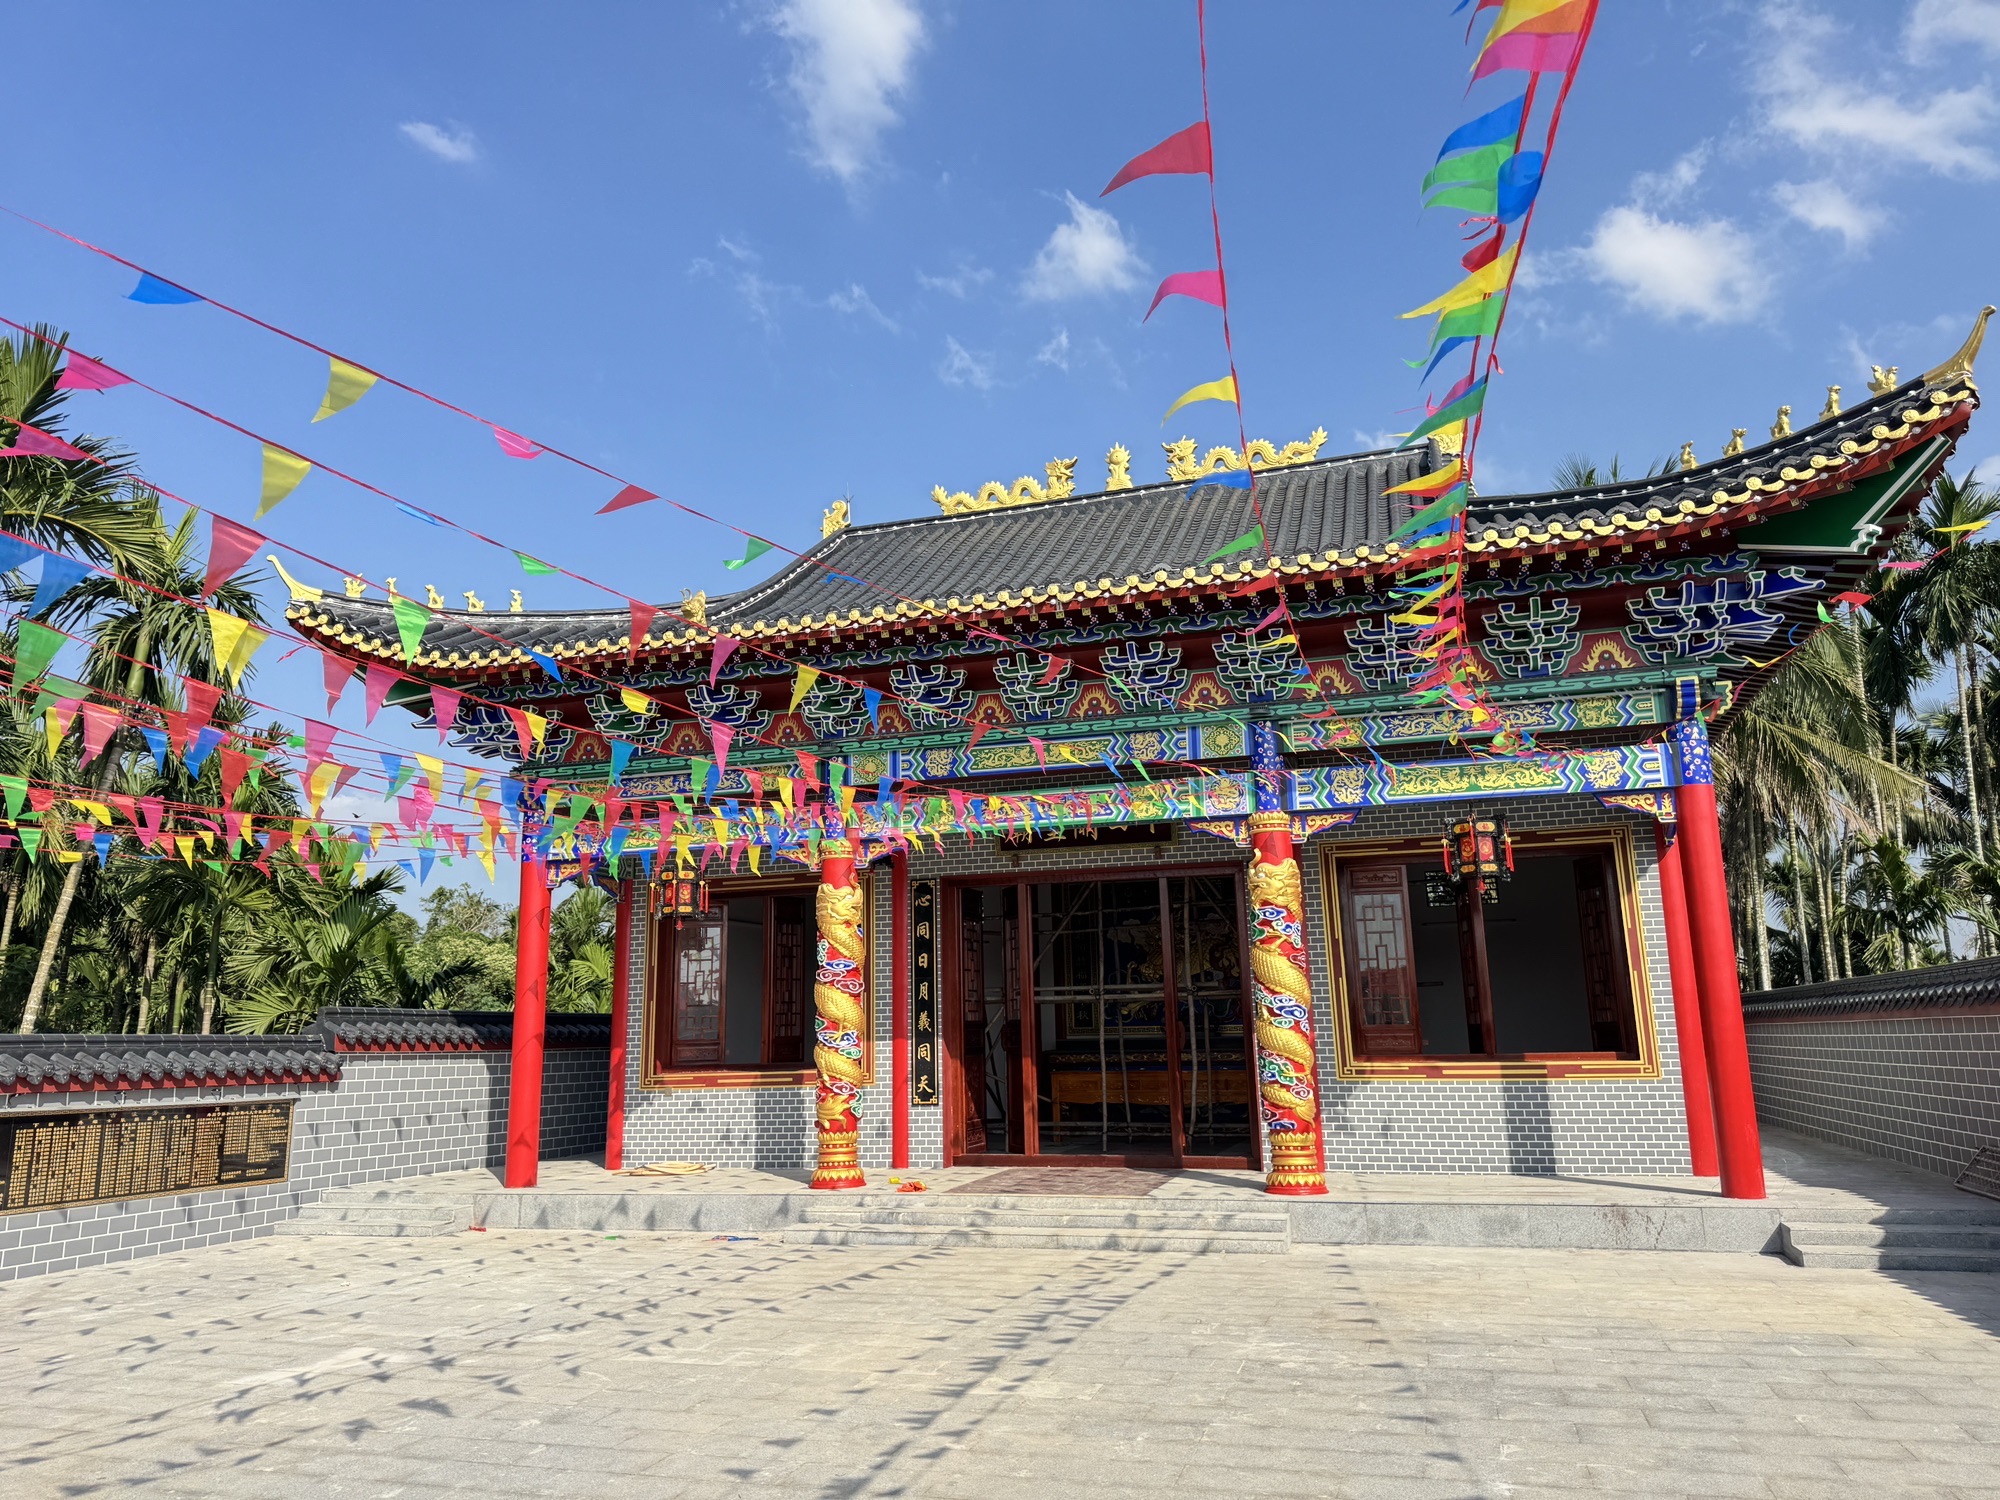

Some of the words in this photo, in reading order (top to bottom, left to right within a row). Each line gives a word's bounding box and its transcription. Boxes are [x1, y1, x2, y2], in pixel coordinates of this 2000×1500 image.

[915, 895, 933, 1093] 心同日月義同天
